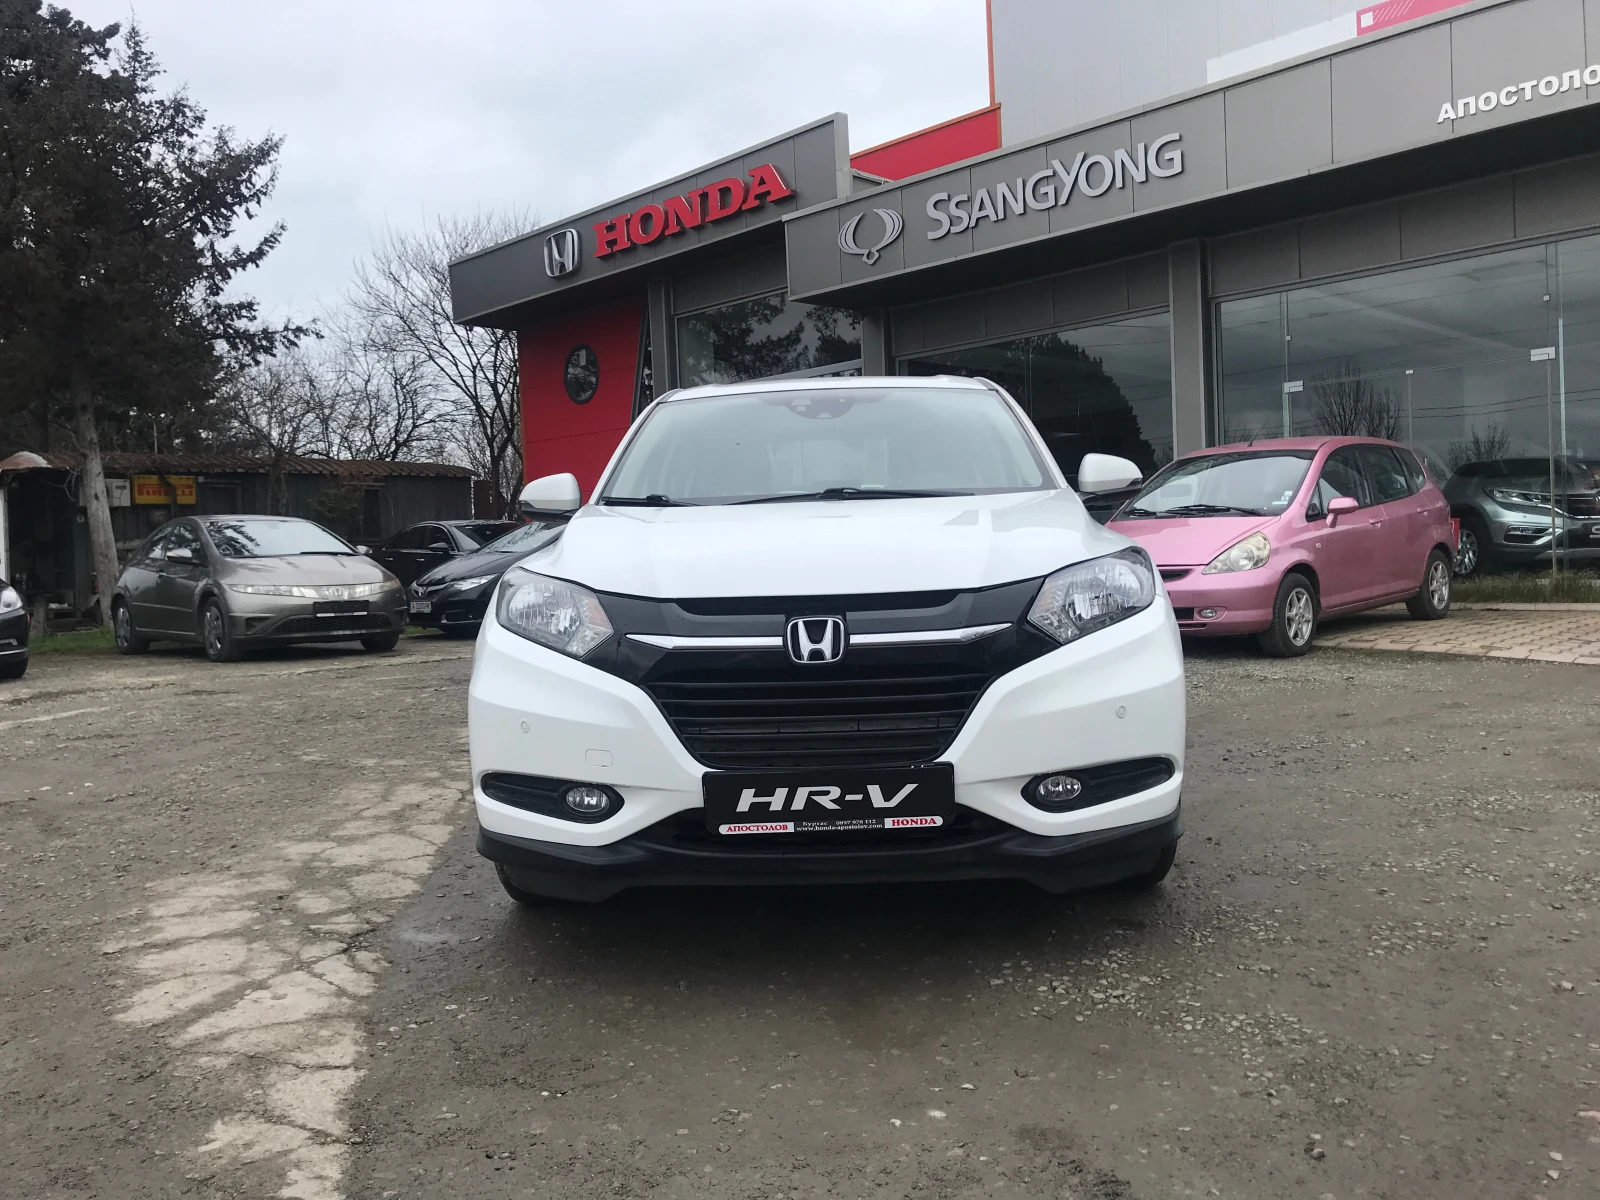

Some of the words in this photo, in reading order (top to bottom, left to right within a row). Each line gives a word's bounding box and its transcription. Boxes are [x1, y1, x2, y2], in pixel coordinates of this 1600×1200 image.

[1437, 64, 1600, 124] АПОСТОЛО
[593, 163, 796, 259] HONDA
[137, 483, 194, 497] PIRELI
[735, 783, 919, 812] HR-V
[726, 823, 788, 833] АПОСТОЛОВ
[891, 817, 937, 827] HONDA
